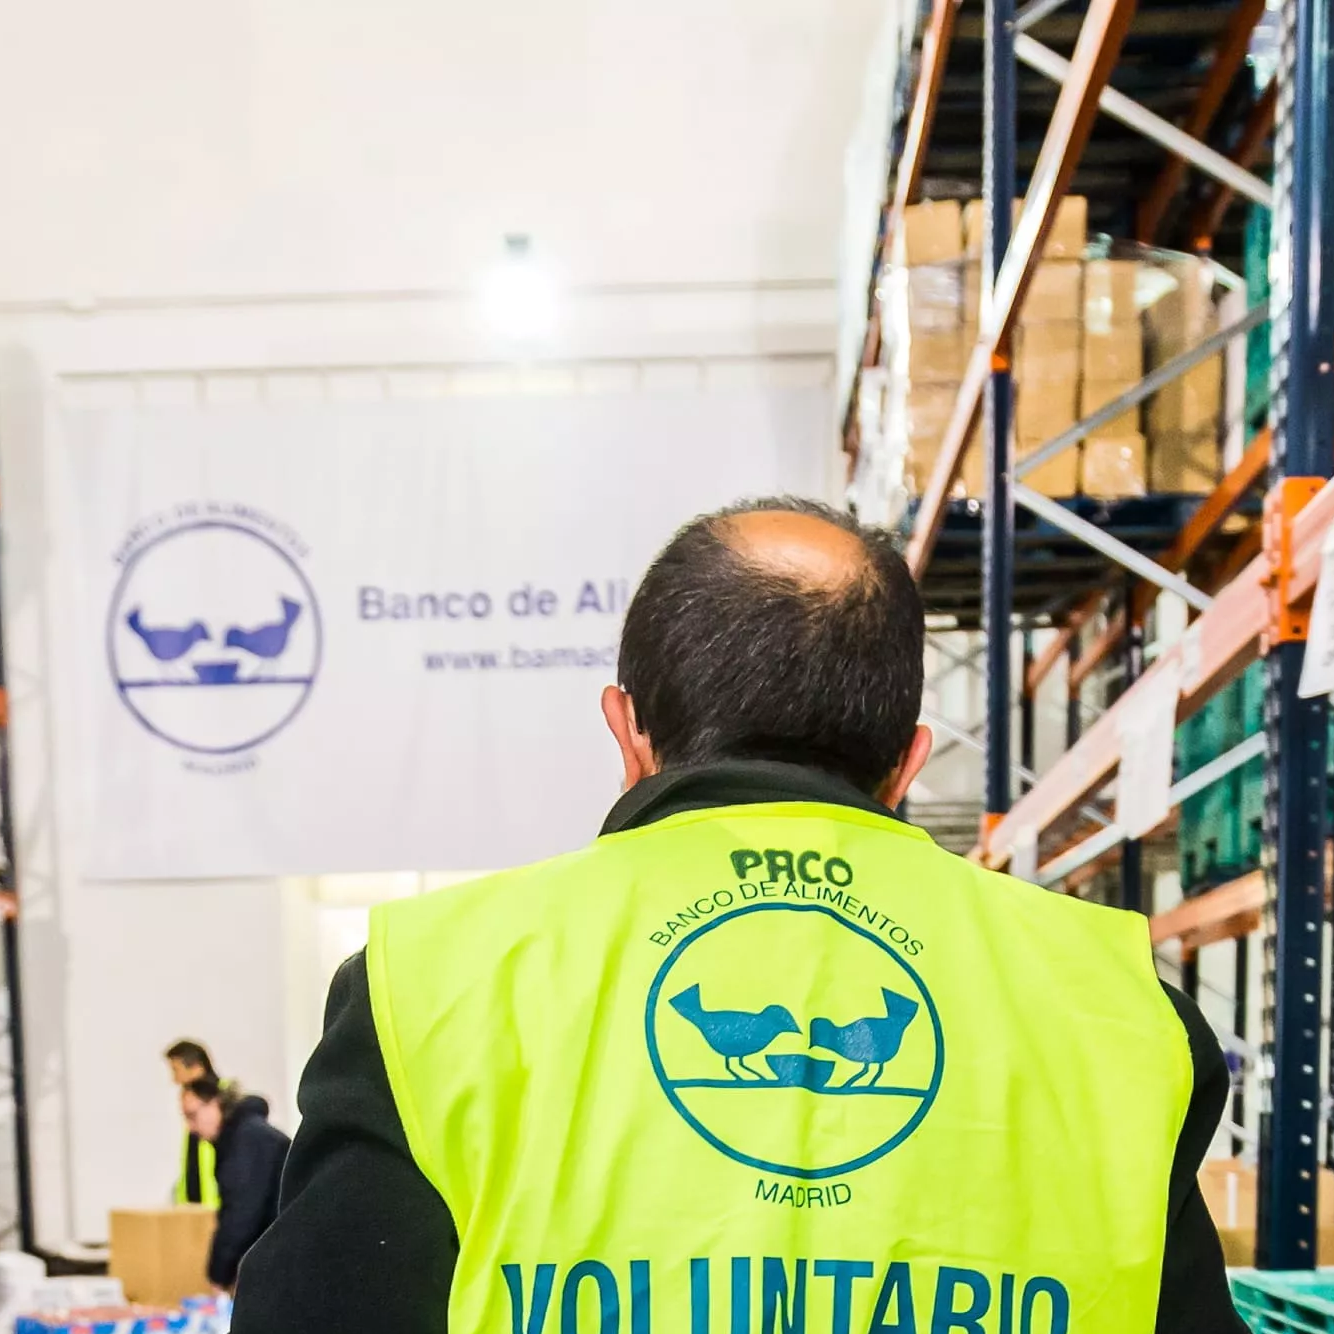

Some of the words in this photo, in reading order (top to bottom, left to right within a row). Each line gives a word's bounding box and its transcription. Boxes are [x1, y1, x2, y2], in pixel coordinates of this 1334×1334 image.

[357, 584, 493, 621] Banco
[508, 578, 559, 617] de
[729, 847, 853, 887] PACO
[649, 889, 734, 947] BANCO
[738, 880, 779, 900] DE
[783, 880, 924, 957] ALIMENTOS
[755, 1178, 852, 1209] MADRID
